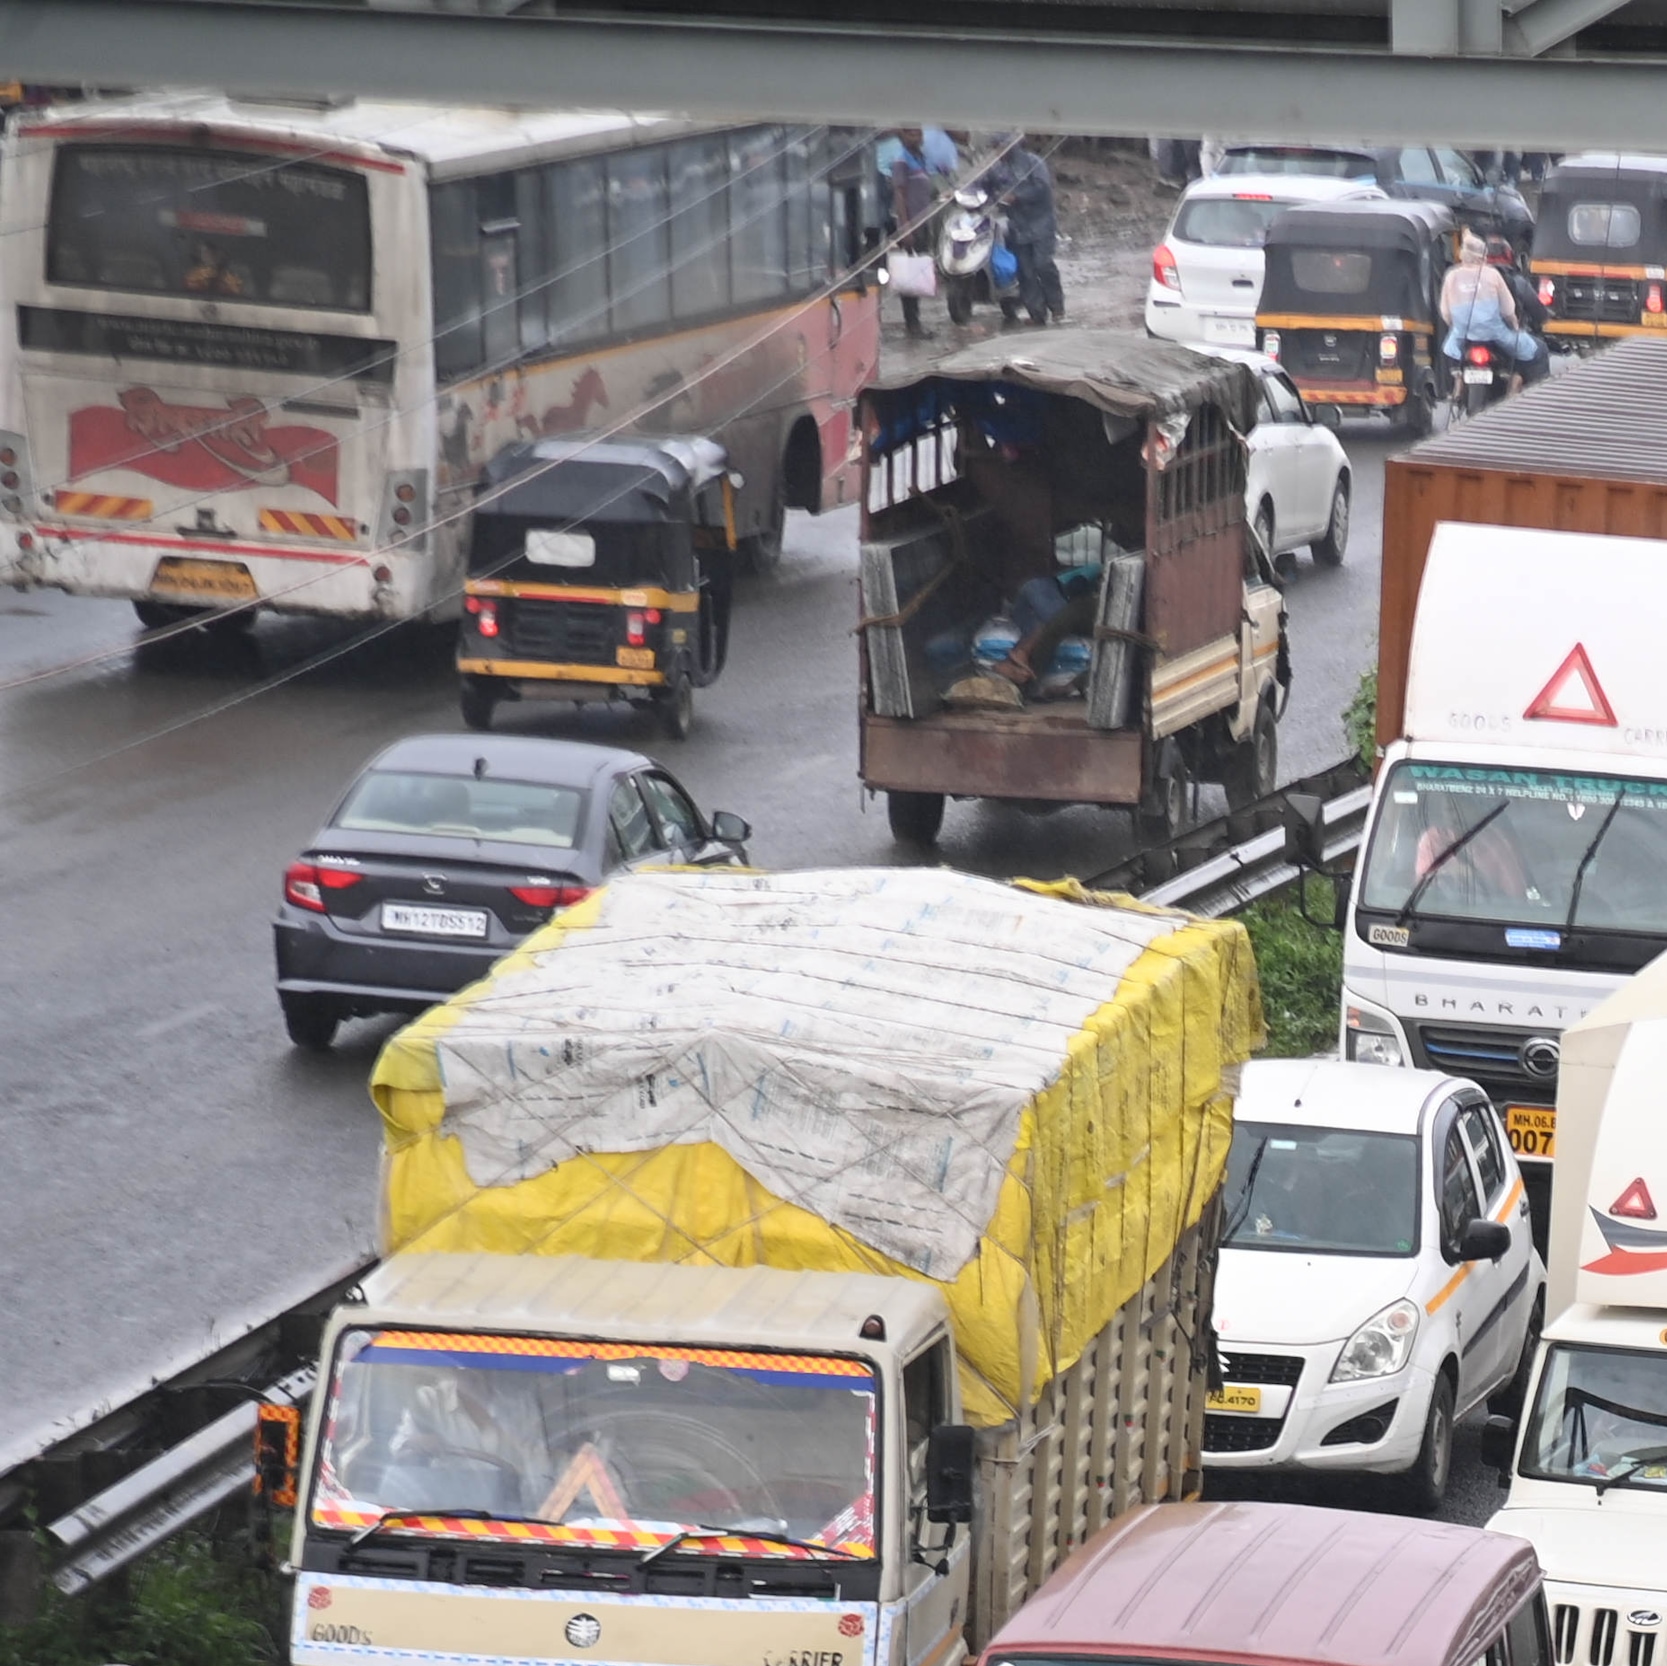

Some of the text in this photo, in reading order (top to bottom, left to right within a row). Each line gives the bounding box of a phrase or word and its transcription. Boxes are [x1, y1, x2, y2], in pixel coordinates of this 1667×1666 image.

[1409, 765, 1537, 786] WASAN
[1373, 928, 1408, 945] GOODS
[311, 1621, 376, 1648] GOODS
